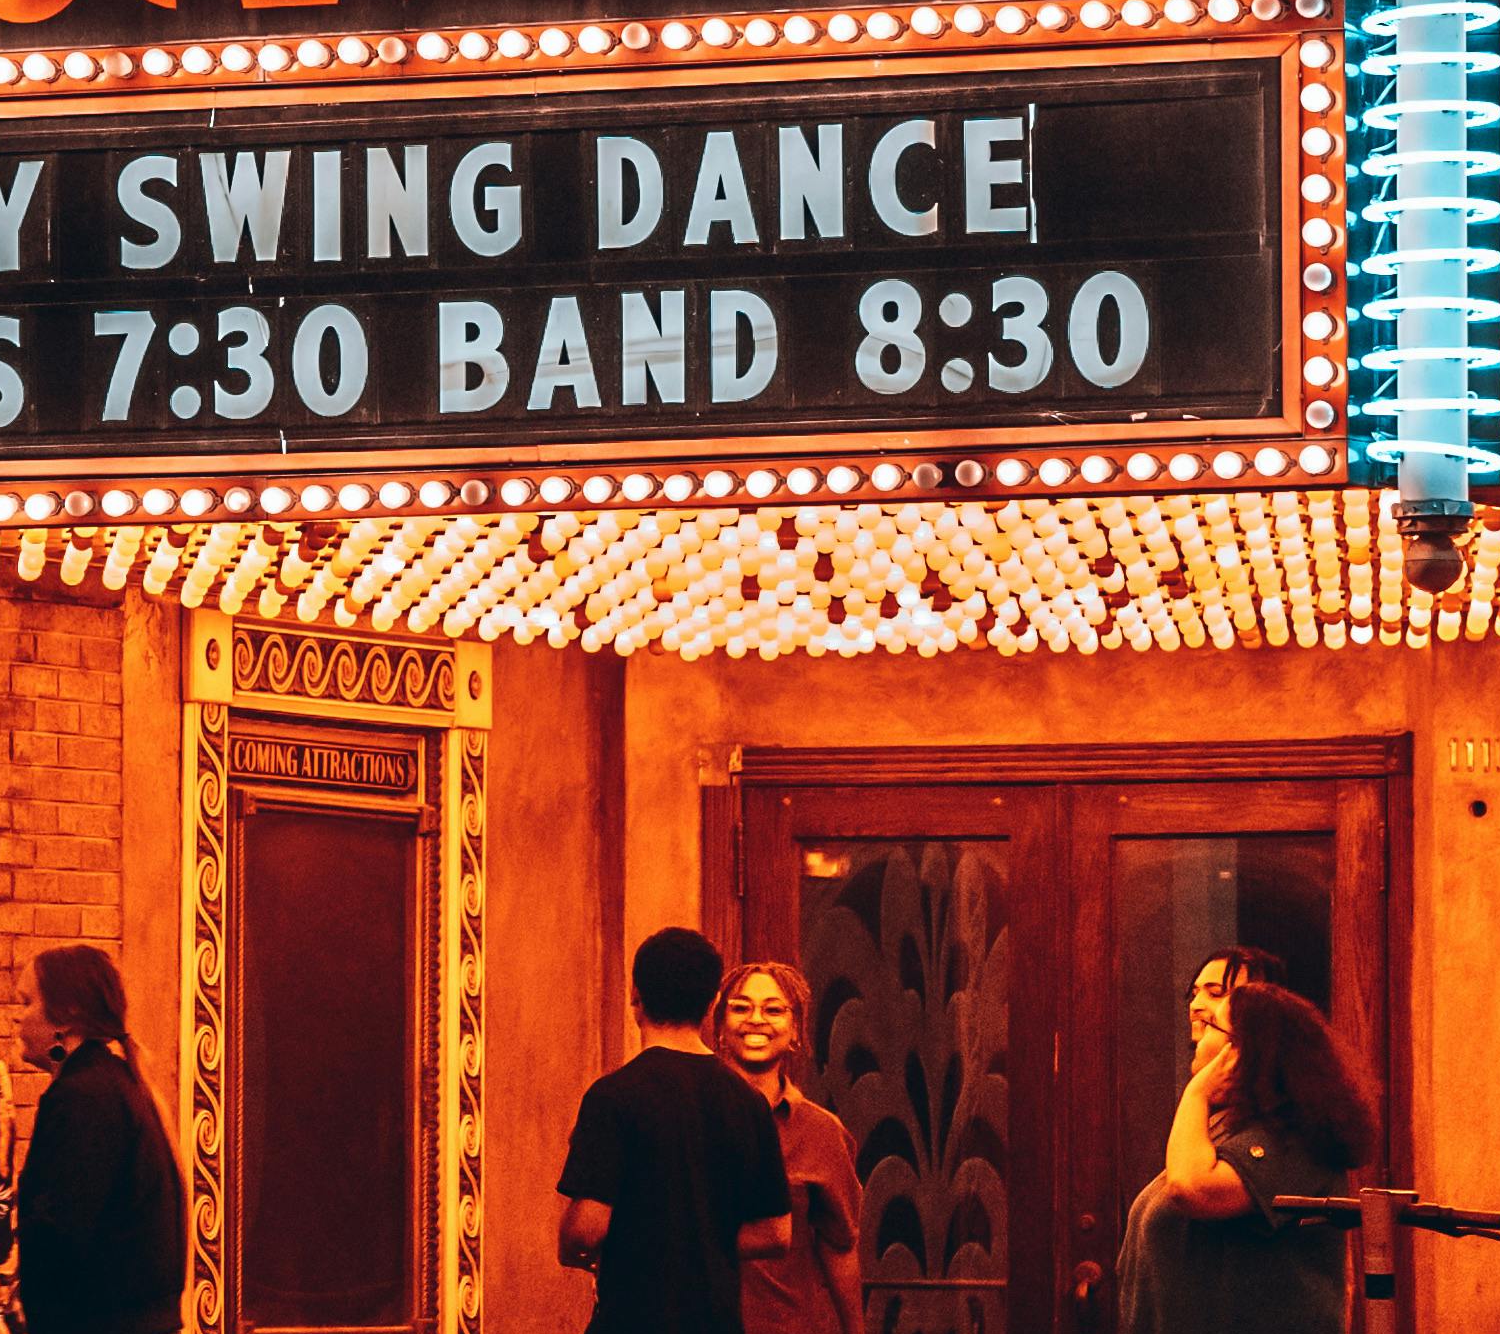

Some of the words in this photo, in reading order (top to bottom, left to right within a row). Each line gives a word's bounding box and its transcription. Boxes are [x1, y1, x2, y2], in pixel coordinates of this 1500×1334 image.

[117, 141, 523, 269] SWING
[597, 117, 1027, 250] DANCE
[94, 303, 370, 422] 7:30
[438, 289, 778, 415] BAND
[855, 270, 1150, 395] 8:30
[233, 740, 298, 776] COMING
[302, 748, 405, 786] ATTRACTIONS
